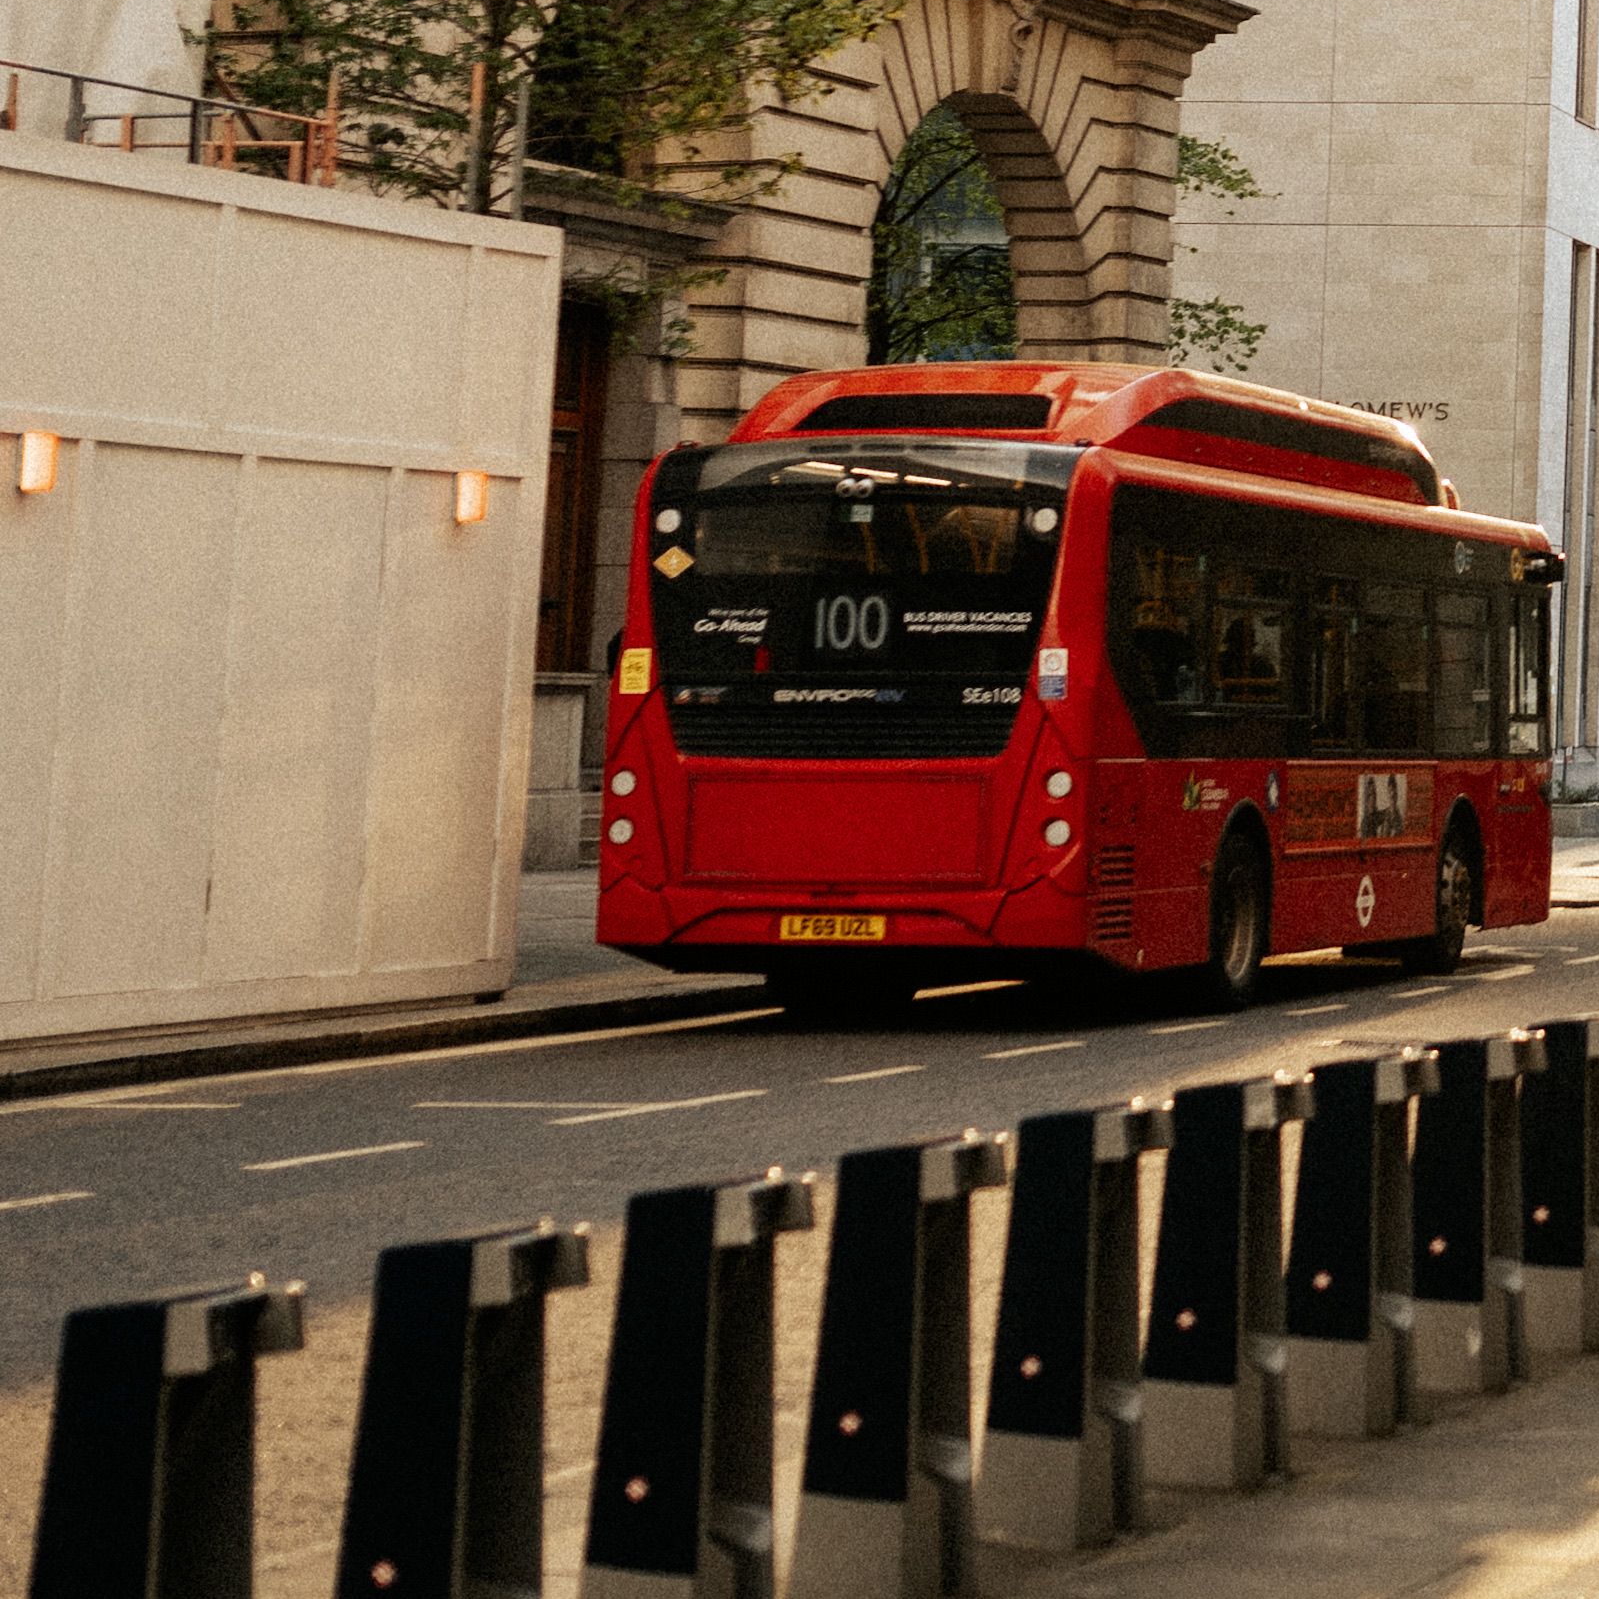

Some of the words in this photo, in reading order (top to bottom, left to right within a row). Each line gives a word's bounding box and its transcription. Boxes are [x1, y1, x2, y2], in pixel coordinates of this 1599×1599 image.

[1336, 401, 1450, 421] OMEW'S
[693, 617, 769, 633] Go-Ahead
[814, 595, 888, 650] 100
[926, 611, 967, 623] DRIVER
[968, 611, 1033, 623] VACANCIES
[961, 687, 1022, 704] SEe108
